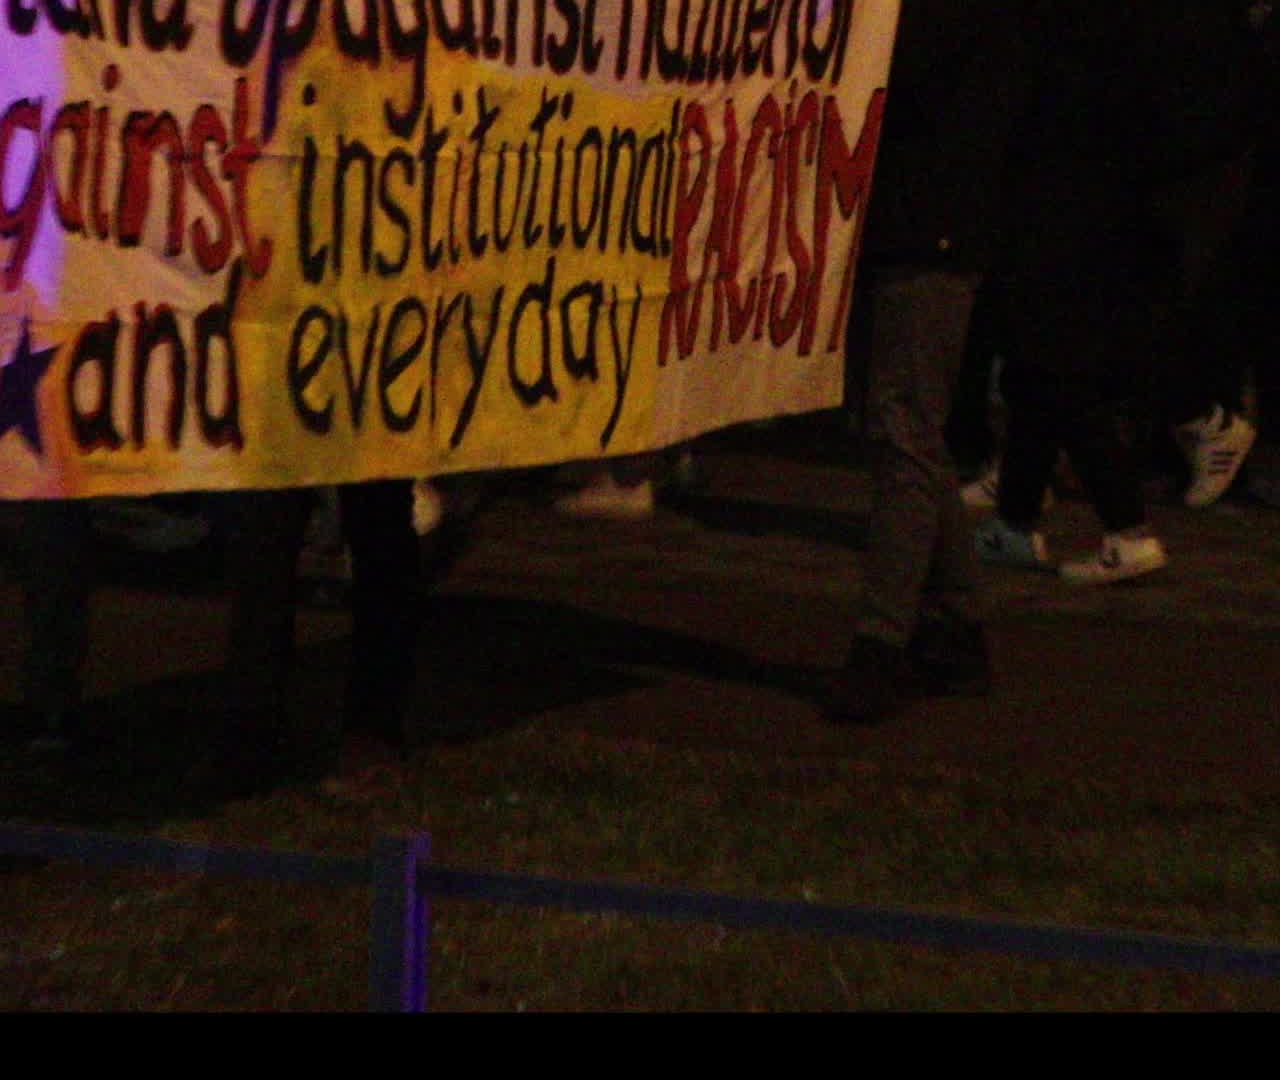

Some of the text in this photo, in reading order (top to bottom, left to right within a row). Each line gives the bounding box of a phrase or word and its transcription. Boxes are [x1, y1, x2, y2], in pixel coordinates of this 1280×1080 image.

[298, 84, 680, 283] institutional
[68, 255, 643, 453] and everyday
